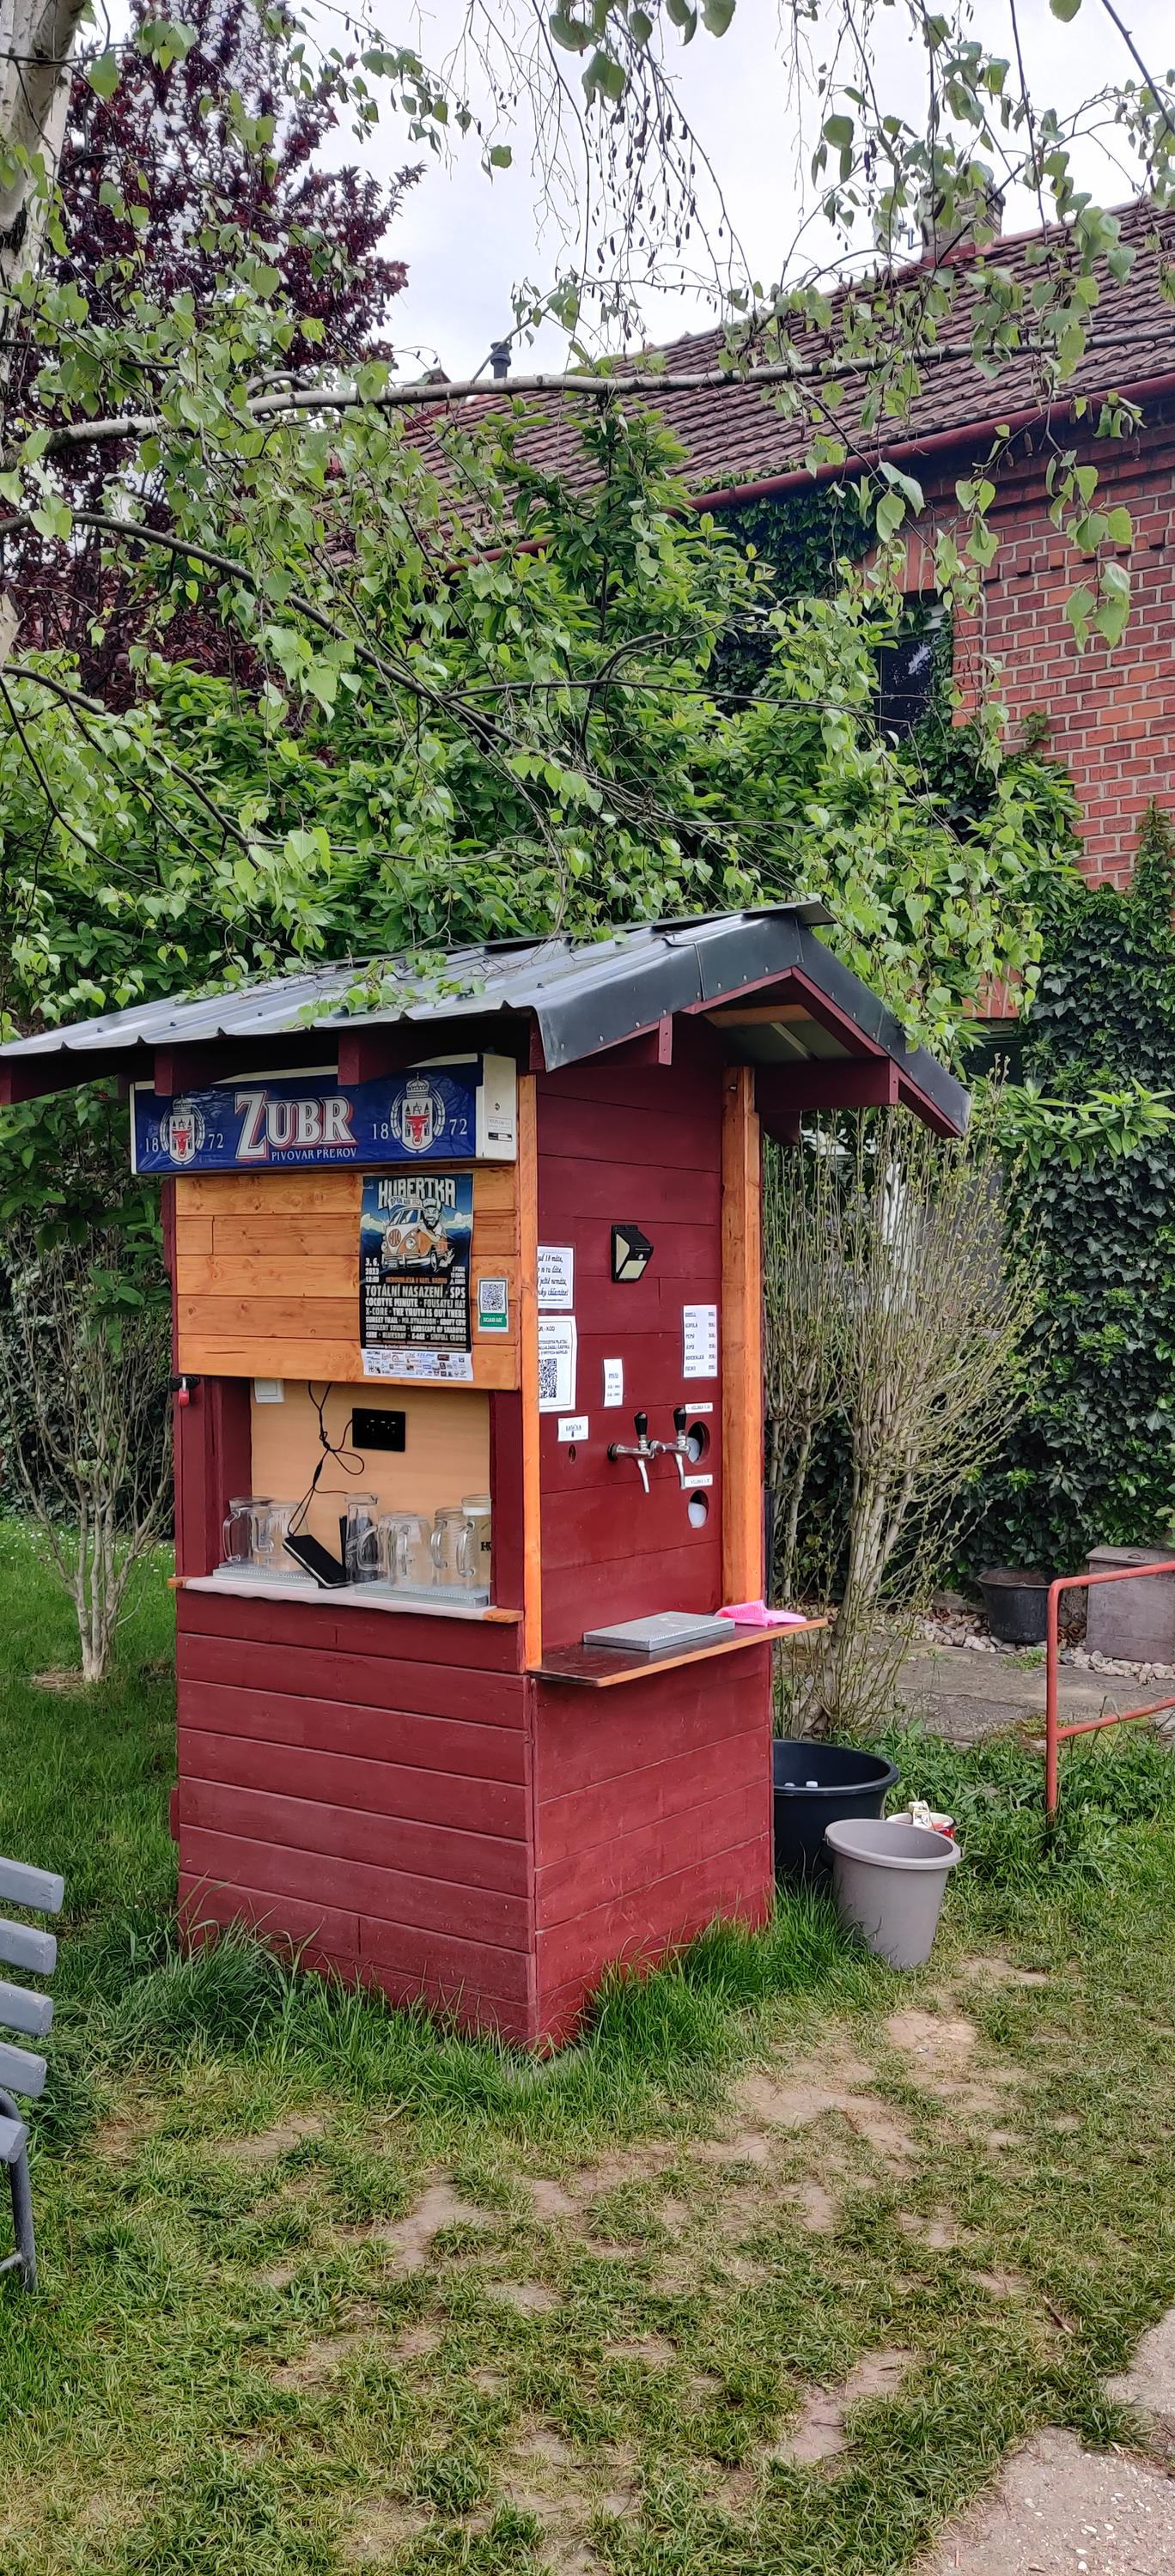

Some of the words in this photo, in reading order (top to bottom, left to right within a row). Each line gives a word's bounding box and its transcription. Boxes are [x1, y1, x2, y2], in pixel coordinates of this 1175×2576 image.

[234, 1090, 356, 1159] ZUBR
[373, 1122, 389, 1140] 18
[449, 1118, 467, 1136] 72
[145, 1137, 159, 1152] 18
[208, 1133, 224, 1150] 72
[271, 1149, 314, 1161] PIVOVAR
[316, 1146, 357, 1159] PŘEROV
[378, 1176, 457, 1210] HUBERTKA
[365, 1283, 400, 1297] TOTÁLNÍ
[402, 1285, 443, 1298] NASAZENÍ
[450, 1287, 466, 1299] SPS
